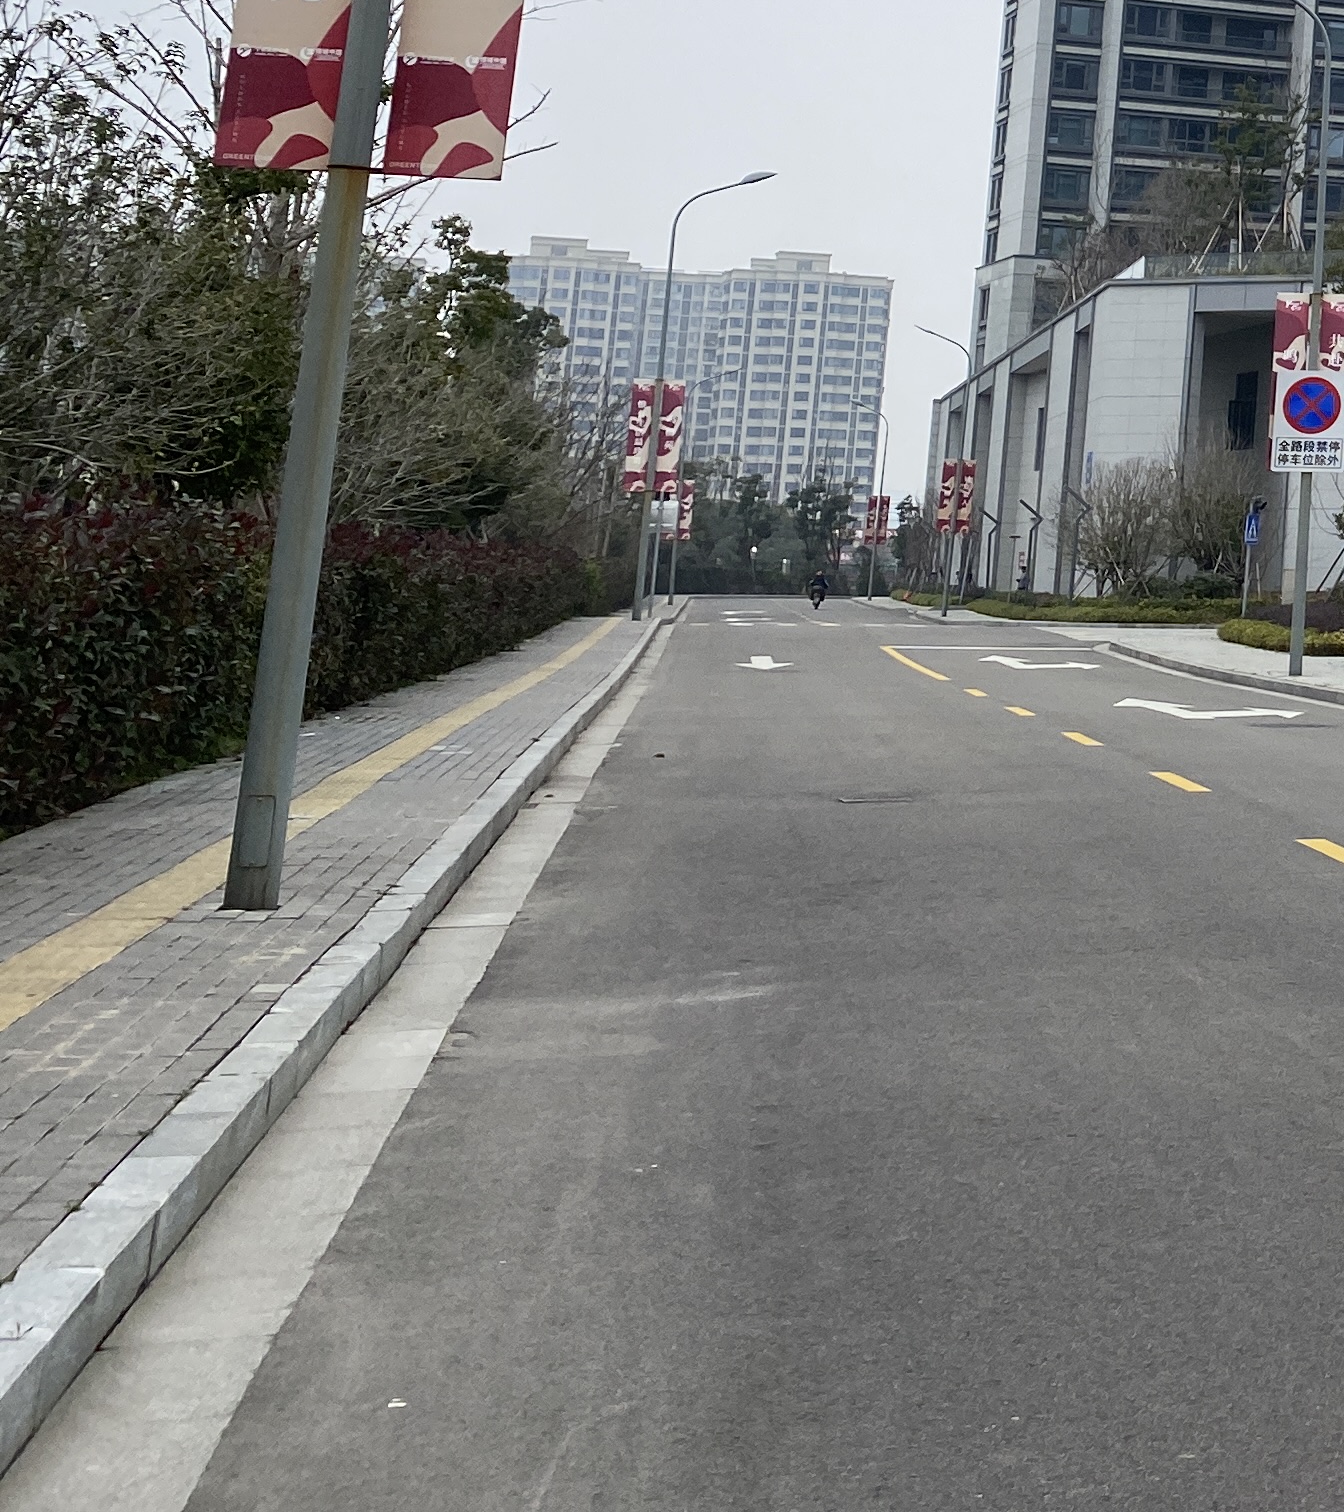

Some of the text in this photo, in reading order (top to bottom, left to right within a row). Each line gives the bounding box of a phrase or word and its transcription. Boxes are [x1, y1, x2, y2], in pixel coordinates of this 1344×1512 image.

[1278, 440, 1340, 453] 全路段禁停
[1277, 454, 1339, 466] 停车位除外
